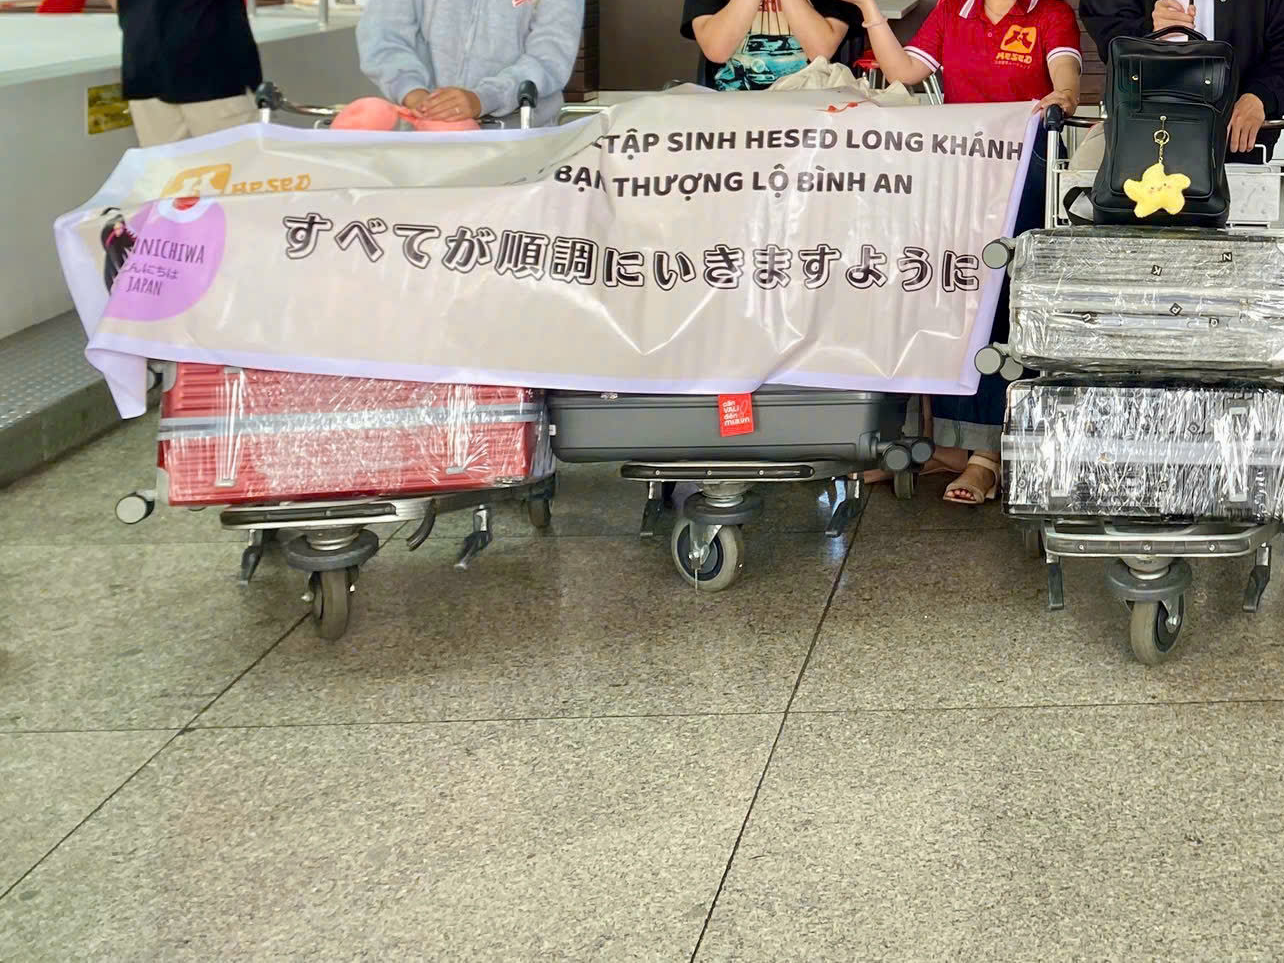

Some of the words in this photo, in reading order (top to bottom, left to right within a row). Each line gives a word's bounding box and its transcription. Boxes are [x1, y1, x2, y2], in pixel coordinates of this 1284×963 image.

[603, 128, 659, 160] TẬP
[667, 131, 736, 152] SINH
[745, 128, 838, 150] HESED
[846, 129, 923, 153] LONG
[932, 131, 1023, 160] KHÁNH
[613, 171, 743, 201] THƯỢNG
[752, 164, 788, 198] LỘ
[797, 166, 865, 193] BÌNH
[873, 174, 912, 194] AN
[132, 238, 206, 264] NICHIWA
[283, 212, 980, 292] すべてが順調にいきますように
[125, 277, 163, 296] JAPAN
